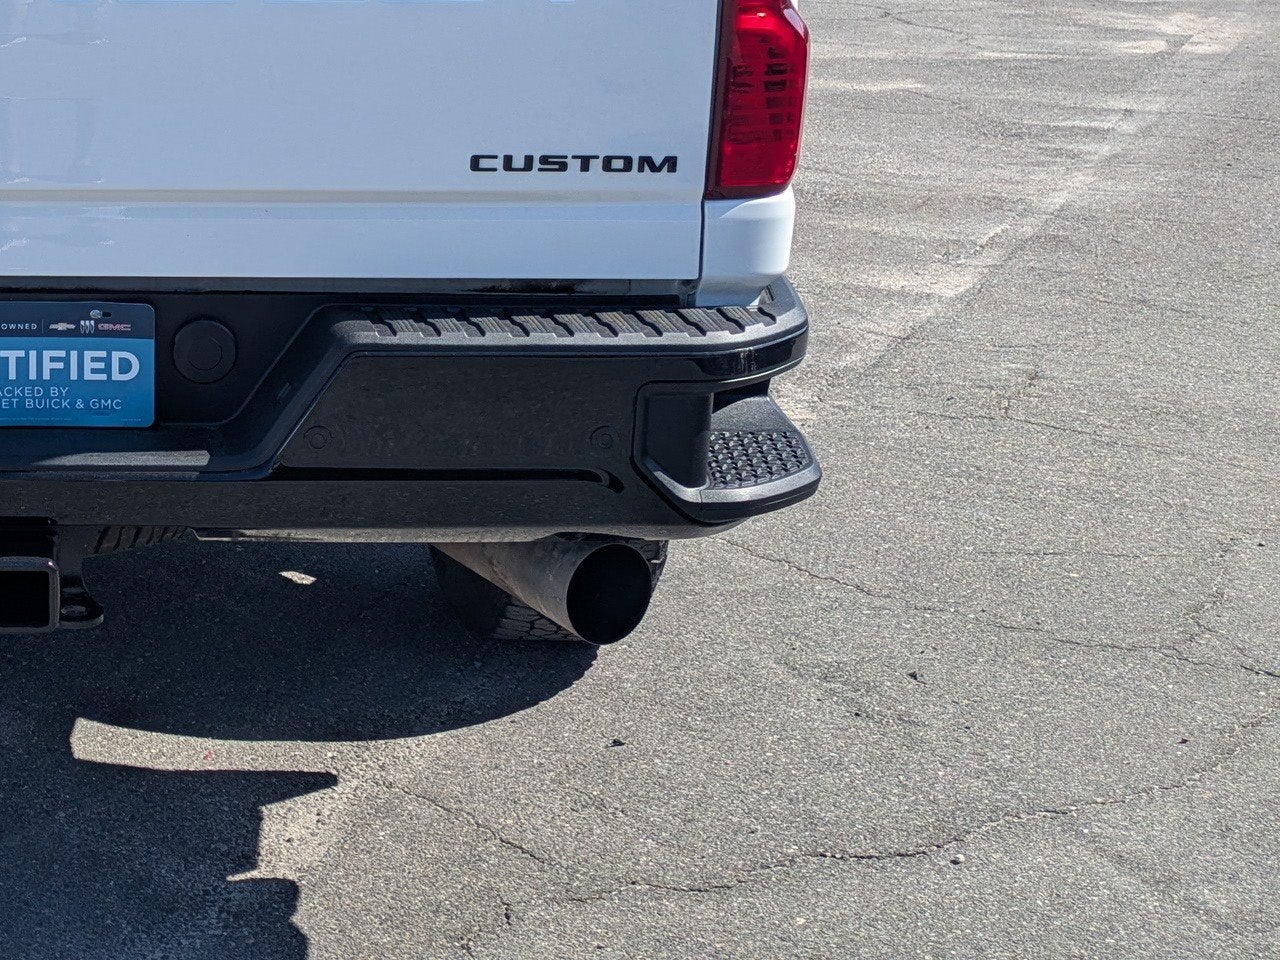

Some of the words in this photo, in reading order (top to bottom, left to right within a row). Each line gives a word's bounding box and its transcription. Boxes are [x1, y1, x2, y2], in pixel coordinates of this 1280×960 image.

[470, 155, 678, 173] CUSTOM
[97, 323, 132, 331] GMC
[50, 387, 69, 397] BY
[25, 398, 71, 409] BUICK
[75, 399, 85, 409] &
[89, 398, 122, 409] GMC
